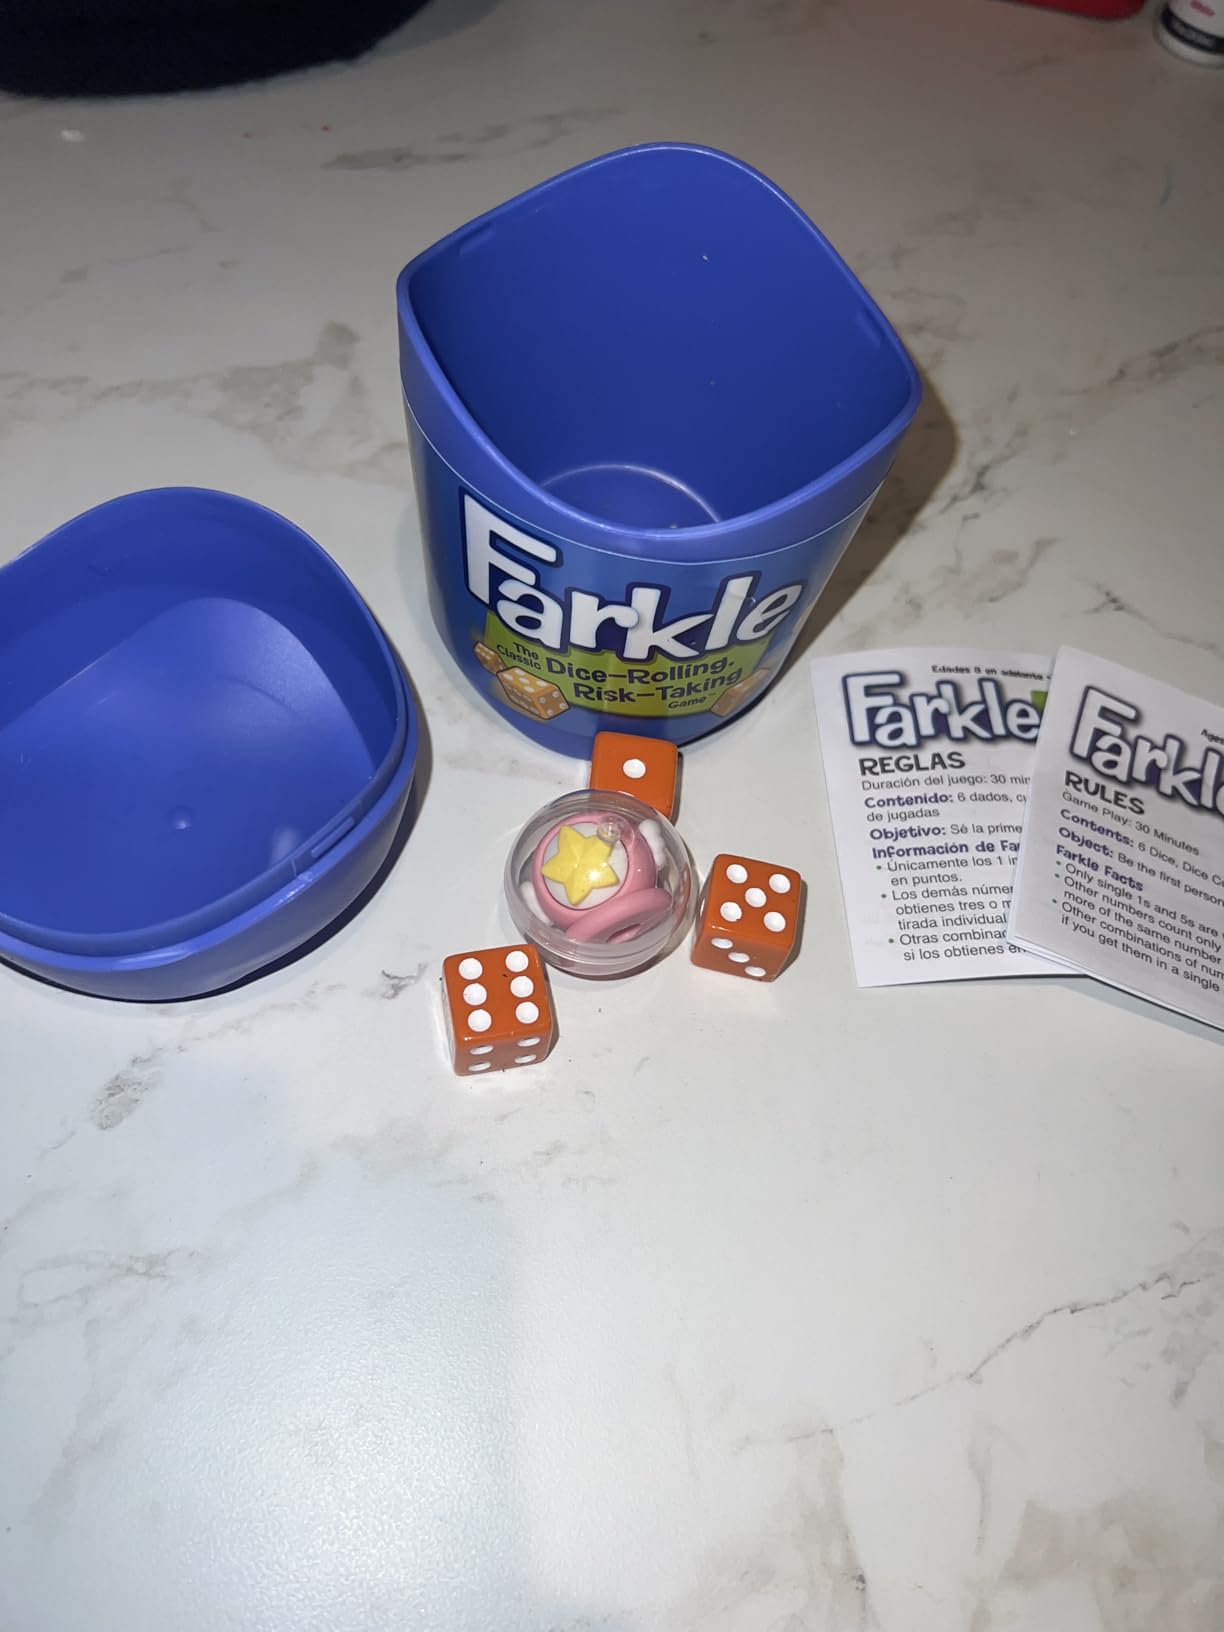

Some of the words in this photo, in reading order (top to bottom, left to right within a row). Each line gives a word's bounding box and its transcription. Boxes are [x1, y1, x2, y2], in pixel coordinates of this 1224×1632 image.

[459, 488, 807, 662] Farkle
[496, 644, 541, 670] Classic
[513, 642, 539, 660] The
[668, 696, 707, 709] Game
[842, 671, 1041, 749] Farkle
[858, 752, 965, 776] REGLAS
[862, 777, 920, 791] Duración
[924, 775, 944, 786] del
[947, 774, 987, 787] juego:
[990, 774, 1006, 785] 30
[1064, 770, 1145, 815] RULES
[864, 792, 954, 808] Contenido:
[957, 791, 966, 802] 6
[969, 792, 1013, 804] dados,
[866, 811, 883, 822] de
[887, 808, 940, 823] jugadas
[1062, 791, 1098, 813] Game
[1102, 807, 1132, 827] Play:
[1135, 821, 1150, 834] 30
[1153, 829, 1200, 856] Minutes
[869, 825, 946, 842] Objetivo:
[950, 823, 968, 835] Sé
[972, 823, 984, 834] la
[987, 822, 1023, 836] prime
[872, 842, 969, 859] Información
[975, 841, 995, 853] de
[1060, 809, 1134, 848] Contents:
[1138, 842, 1146, 852] 6
[1182, 861, 1209, 881] Dice
[887, 857, 969, 872] Únicamente
[972, 856, 992, 867] los
[996, 855, 1003, 866] 1
[1056, 844, 1099, 872] Farkle
[1104, 865, 1144, 892] Facts
[1058, 826, 1113, 858] Object:
[1117, 852, 1134, 868] Be
[1137, 861, 1156, 877] the
[1159, 871, 1181, 889] first
[891, 876, 908, 886] en
[912, 873, 962, 887] puntos.
[892, 889, 918, 901] Los
[921, 885, 968, 899] demás
[1065, 863, 1094, 884] Only
[1097, 878, 1133, 901] single
[1137, 895, 1151, 909] 1s
[1153, 904, 1178, 920] and
[1198, 923, 1219, 937] are
[896, 902, 955, 916] obtienes
[958, 900, 985, 911] tres
[988, 900, 998, 909] o
[1064, 876, 1099, 898] Other
[1102, 894, 1155, 924] numbers
[1158, 919, 1193, 940] count
[1195, 935, 1222, 953] only
[898, 917, 938, 931] tirada
[941, 912, 1007, 928] individual
[1064, 890, 1095, 910] more
[1098, 906, 1111, 917] of
[1114, 911, 1134, 928] the
[1136, 923, 1171, 944] same
[1174, 940, 1222, 965] number
[899, 932, 939, 946] Otras
[1062, 901, 1097, 924] Other
[1099, 920, 1182, 962] combinations
[1185, 958, 1198, 969] of
[903, 948, 915, 961] si
[919, 948, 940, 960] los
[943, 944, 1005, 958] obtienes
[1061, 914, 1070, 926] if
[1072, 921, 1095, 938] you
[1098, 933, 1119, 949] get
[1121, 942, 1153, 964] them
[1156, 956, 1168, 971] in
[1171, 965, 1180, 976] a
[1183, 970, 1220, 992] single
